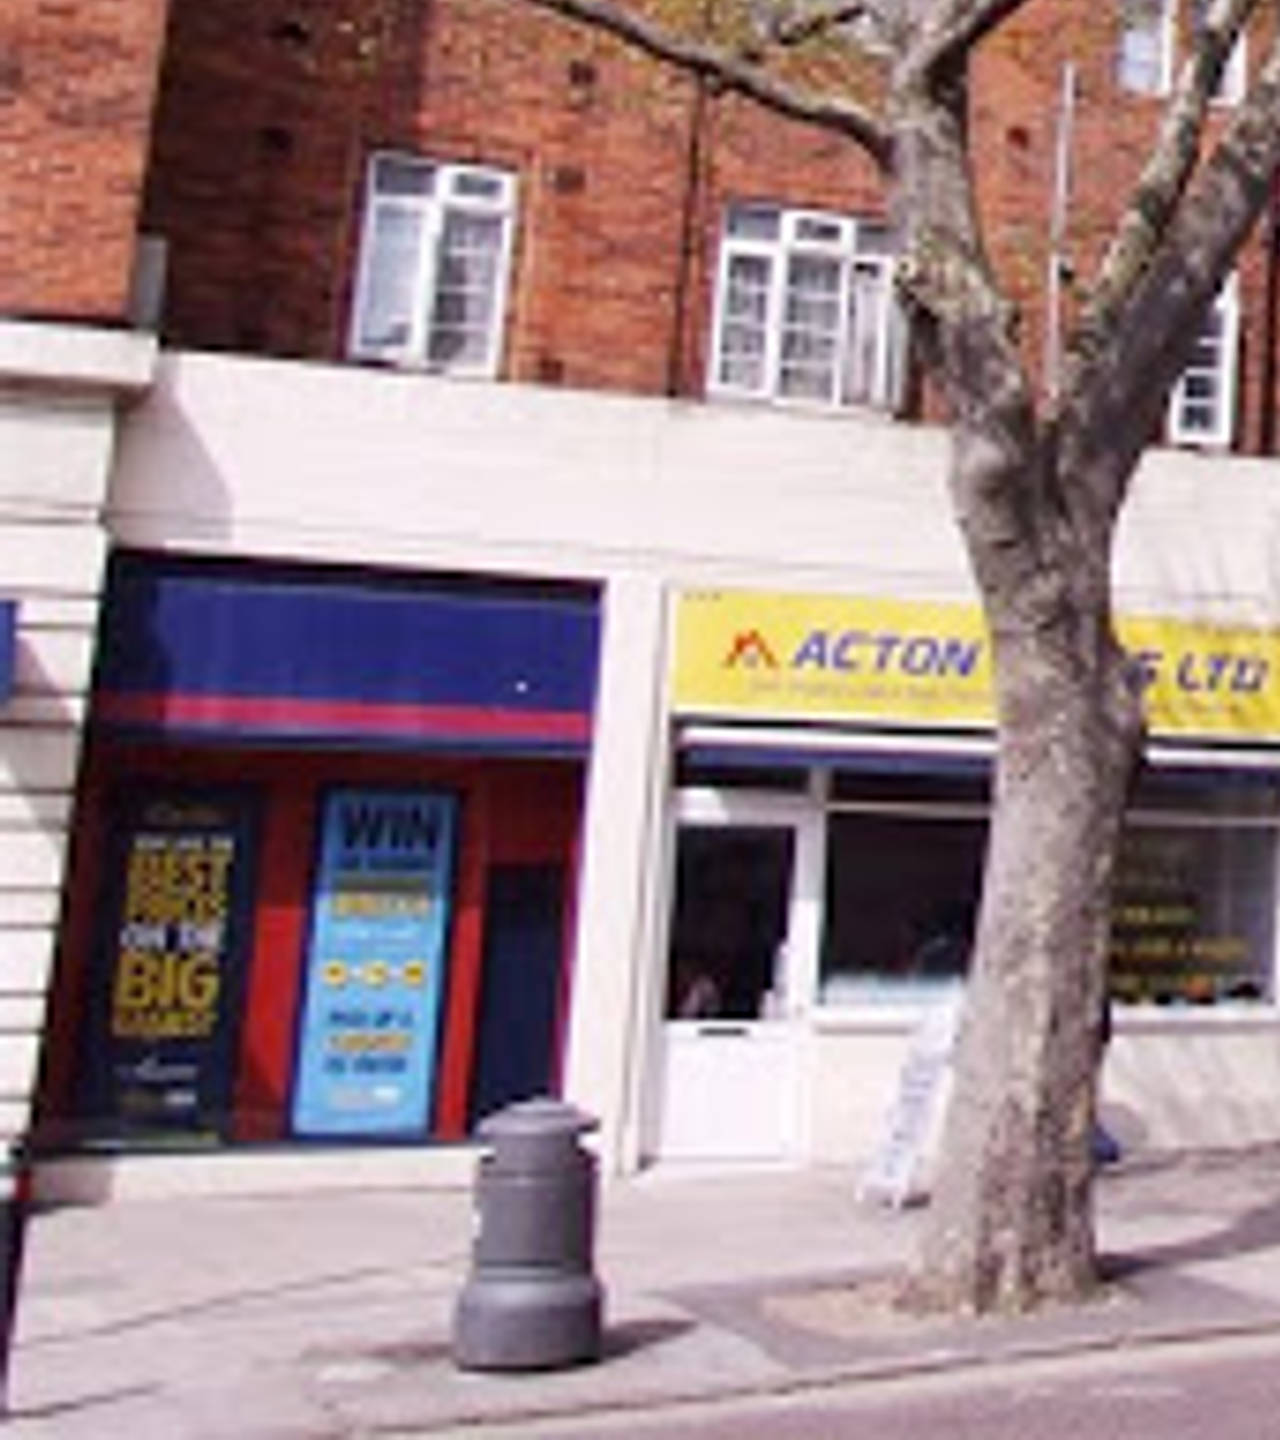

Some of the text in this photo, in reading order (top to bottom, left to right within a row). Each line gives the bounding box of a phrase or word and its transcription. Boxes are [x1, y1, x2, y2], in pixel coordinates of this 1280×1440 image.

[790, 628, 982, 678] ACTON
[1177, 653, 1269, 692] LTD
[340, 800, 443, 851] WIN
[114, 952, 220, 1008] BIG
